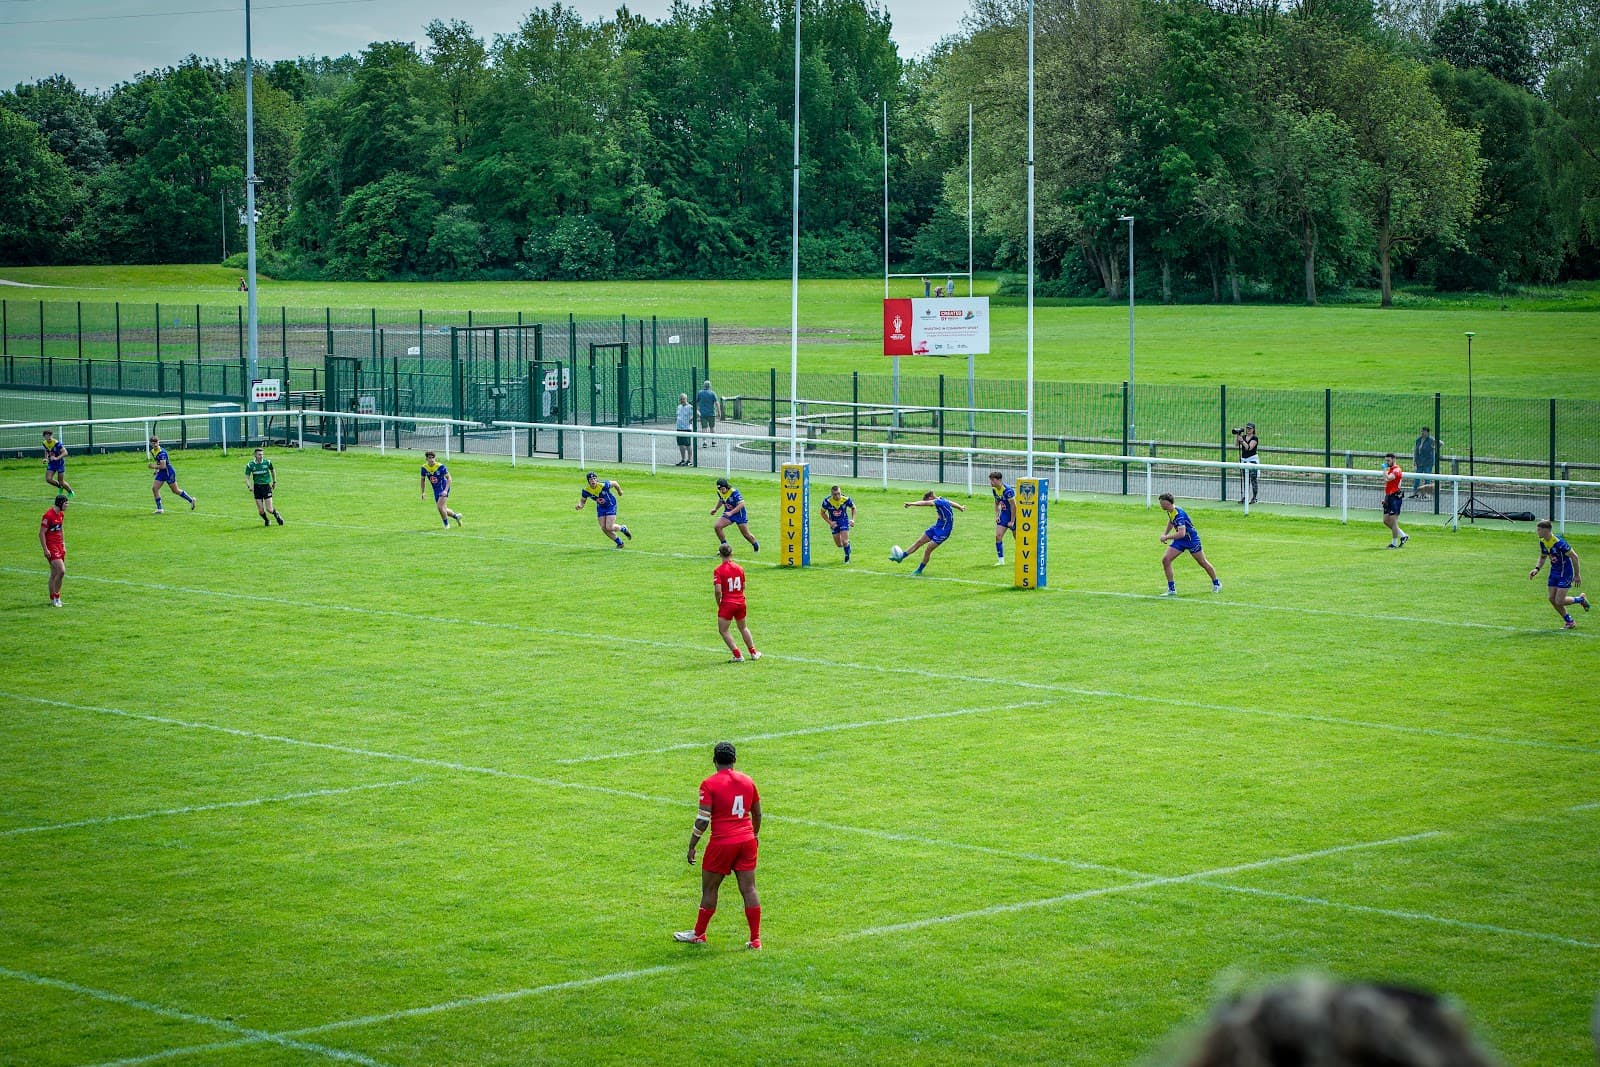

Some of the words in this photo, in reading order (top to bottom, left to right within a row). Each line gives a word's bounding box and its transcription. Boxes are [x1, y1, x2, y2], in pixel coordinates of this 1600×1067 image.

[786, 492, 797, 566] WOLVES
[1021, 508, 1032, 587] WOLVES
[727, 576, 742, 592] 14
[731, 795, 745, 819] 4
